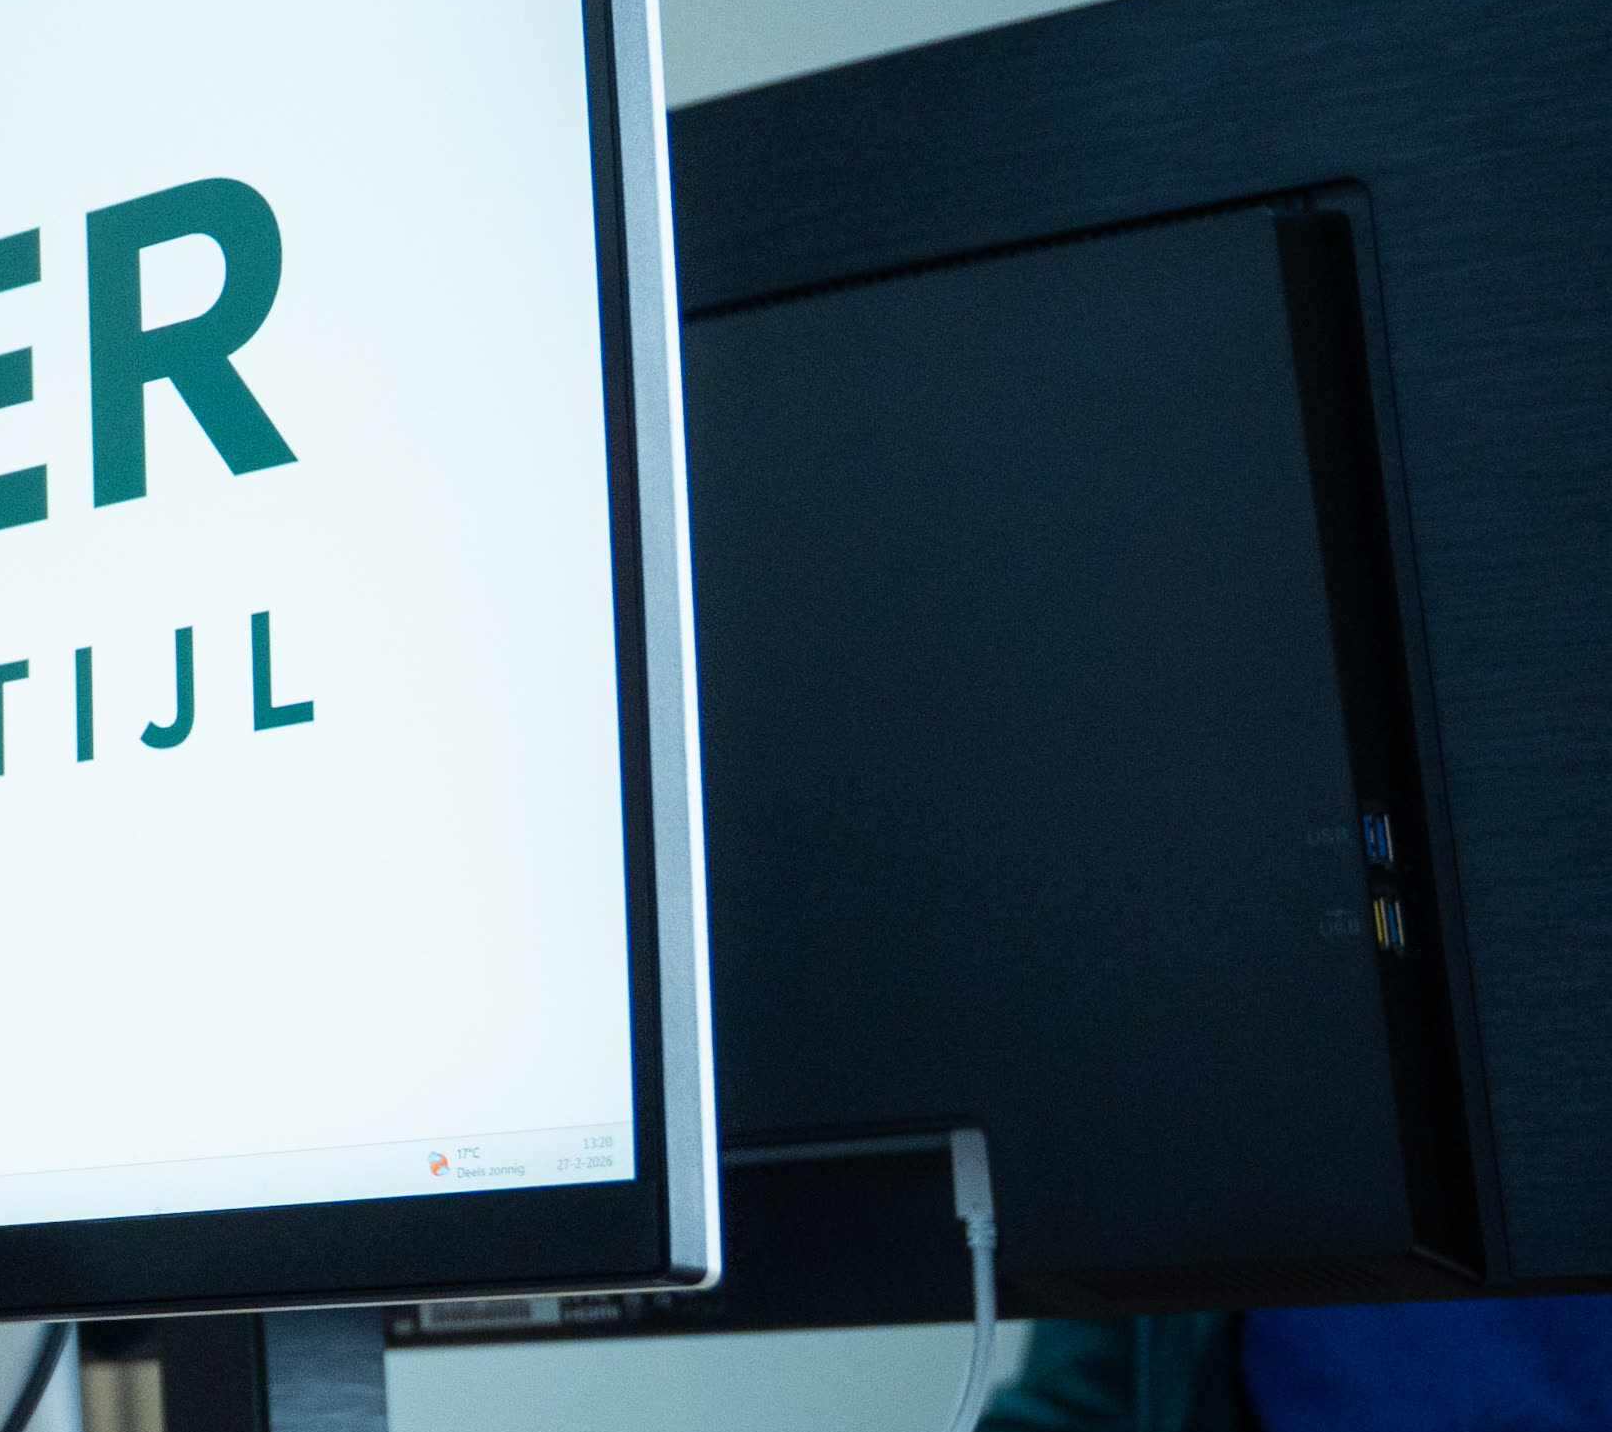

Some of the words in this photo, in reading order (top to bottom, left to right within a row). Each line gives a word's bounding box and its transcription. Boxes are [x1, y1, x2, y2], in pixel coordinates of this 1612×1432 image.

[457, 1146, 481, 1160] 17°C
[557, 1155, 613, 1171] 27-2-2026
[457, 1166, 486, 1179] Deels
[489, 1164, 526, 1177] zonnig
